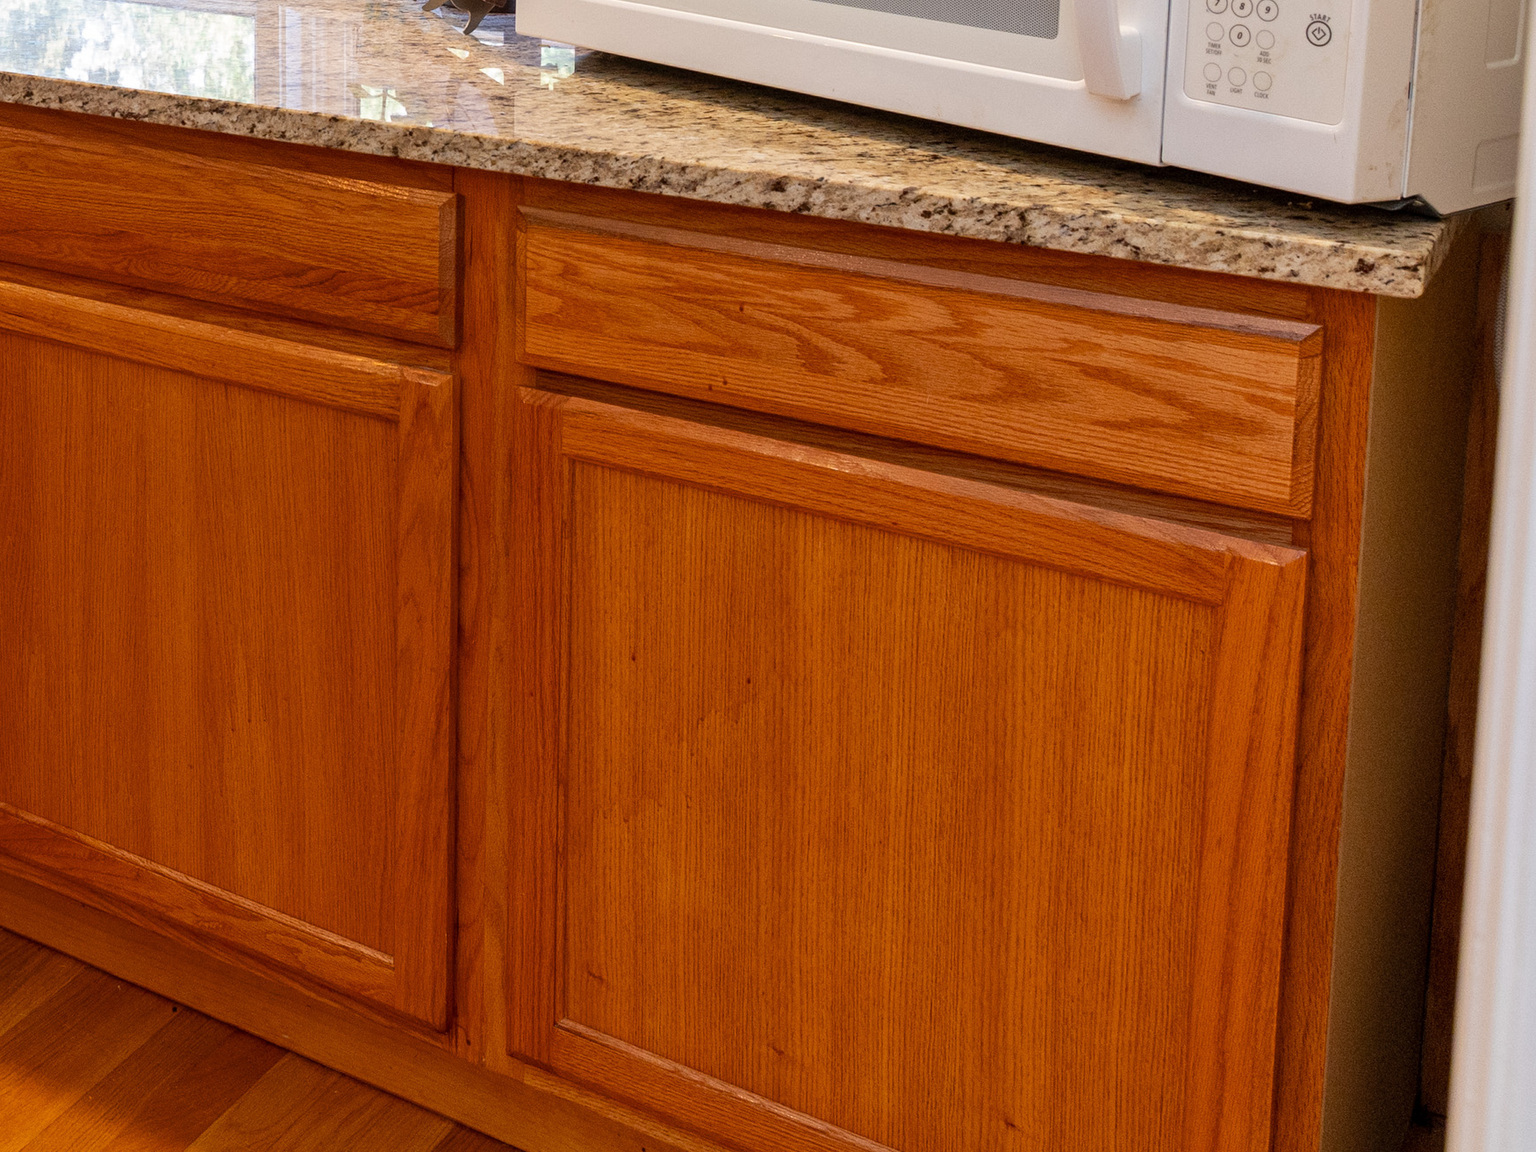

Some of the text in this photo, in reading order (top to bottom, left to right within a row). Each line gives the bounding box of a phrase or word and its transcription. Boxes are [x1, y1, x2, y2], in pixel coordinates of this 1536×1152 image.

[1239, 2, 1245, 10] 8
[1265, 6, 1271, 14] 9
[1309, 13, 1331, 23] START
[1237, 31, 1243, 40] 0
[1206, 82, 1217, 90] VENT
[1254, 91, 1269, 99] CLOCK
